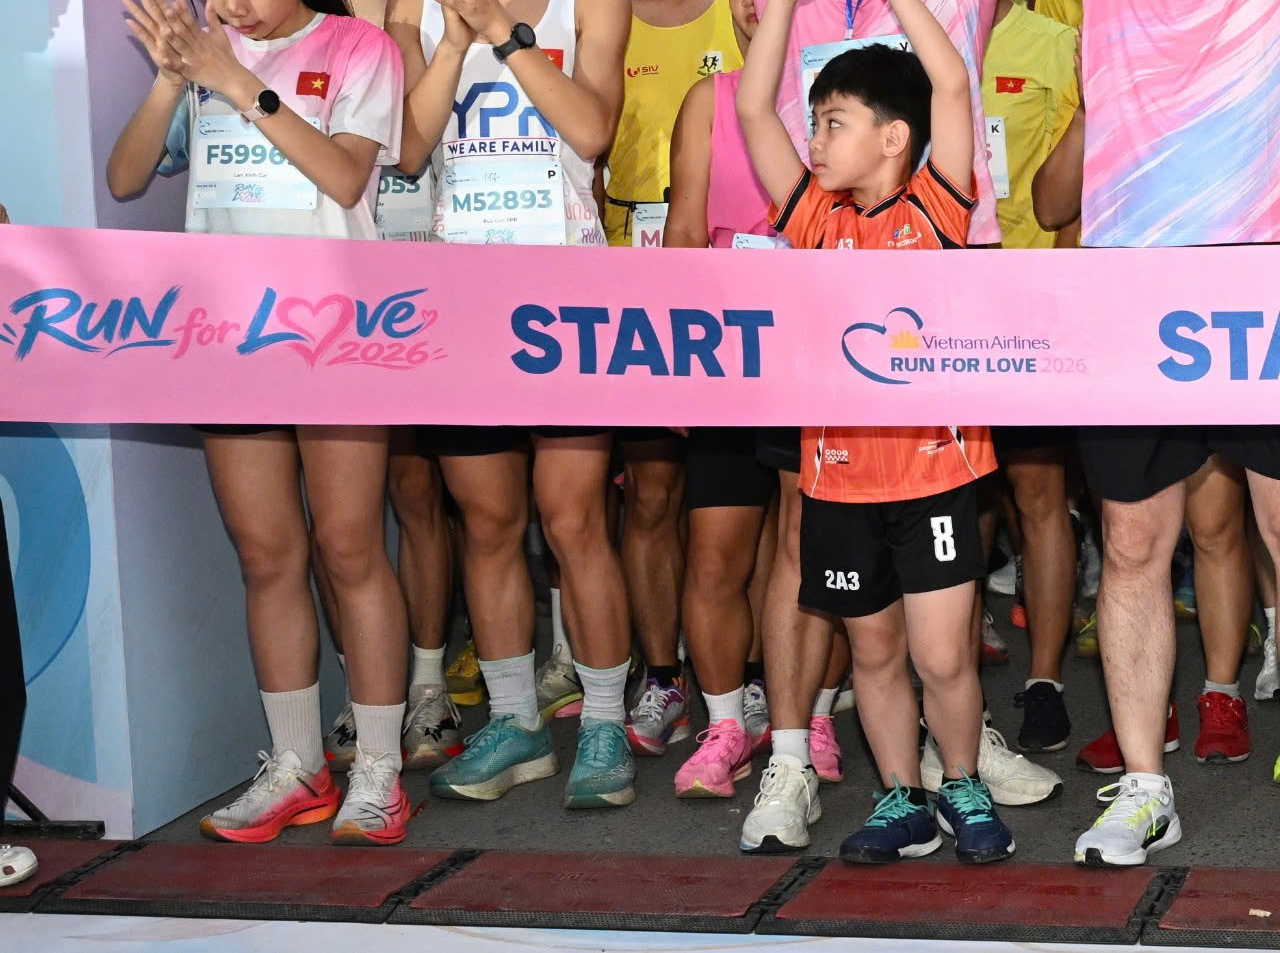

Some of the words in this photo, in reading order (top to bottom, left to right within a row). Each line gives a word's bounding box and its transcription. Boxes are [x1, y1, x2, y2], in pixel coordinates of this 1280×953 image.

[991, 124, 1000, 134] K
[206, 144, 295, 166] F5996
[448, 142, 465, 155] WE
[468, 141, 497, 154] ARE
[502, 140, 556, 153] FAMILY
[547, 170, 556, 180] P
[452, 189, 553, 213] M52893
[172, 306, 242, 359] for
[509, 303, 776, 378] START
[335, 342, 432, 365] 2026
[890, 356, 935, 374] RUN
[940, 356, 981, 374] FOR
[985, 356, 1038, 374] LOVE
[1041, 357, 1088, 375] 2026
[930, 515, 957, 562] 8
[824, 569, 861, 591] 2A3
